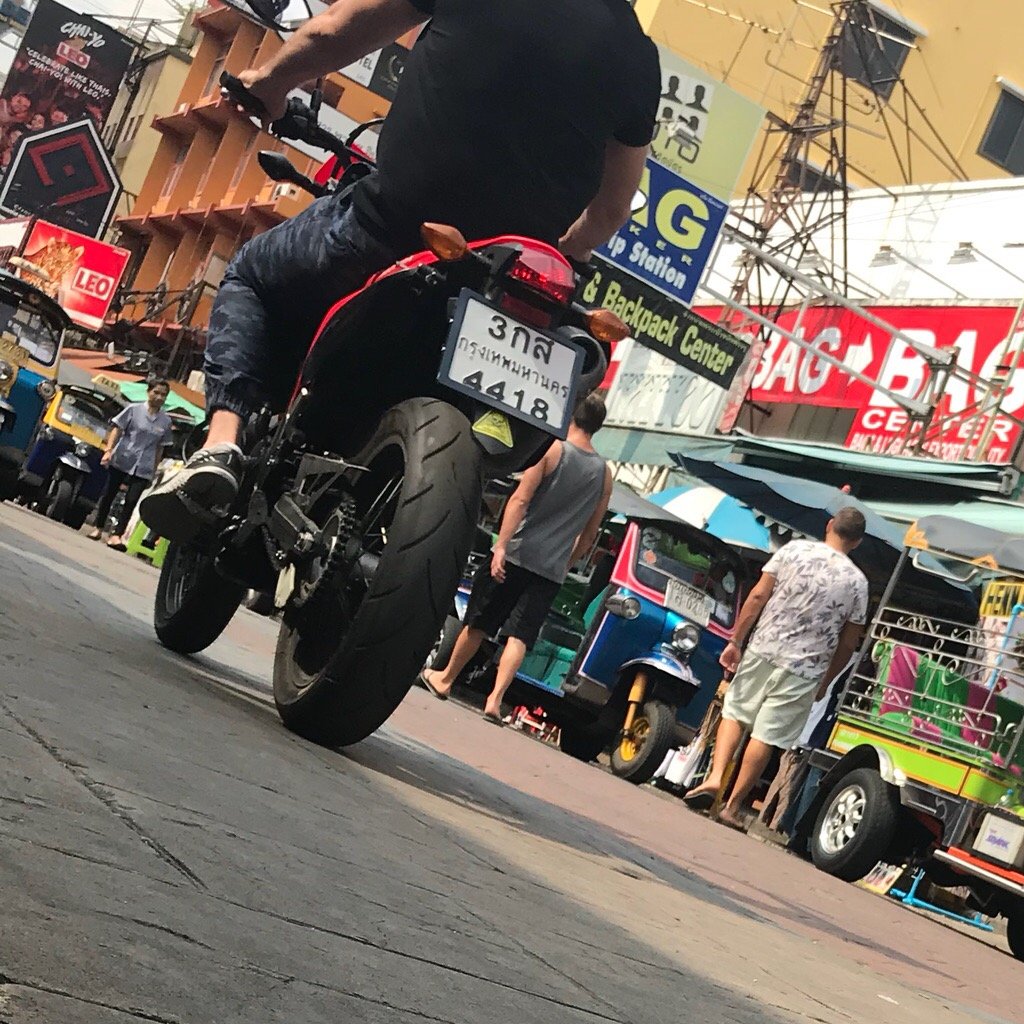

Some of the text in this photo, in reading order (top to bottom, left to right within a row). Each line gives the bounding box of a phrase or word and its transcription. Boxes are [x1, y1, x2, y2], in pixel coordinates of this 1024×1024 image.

[75, 271, 111, 298] LEO
[629, 241, 686, 290] Station
[600, 281, 679, 347] Backpack
[680, 324, 735, 376] Center
[458, 336, 569, 398] กรุงเทพมหานคร
[751, 327, 842, 395] BAG
[463, 370, 549, 422] 4418
